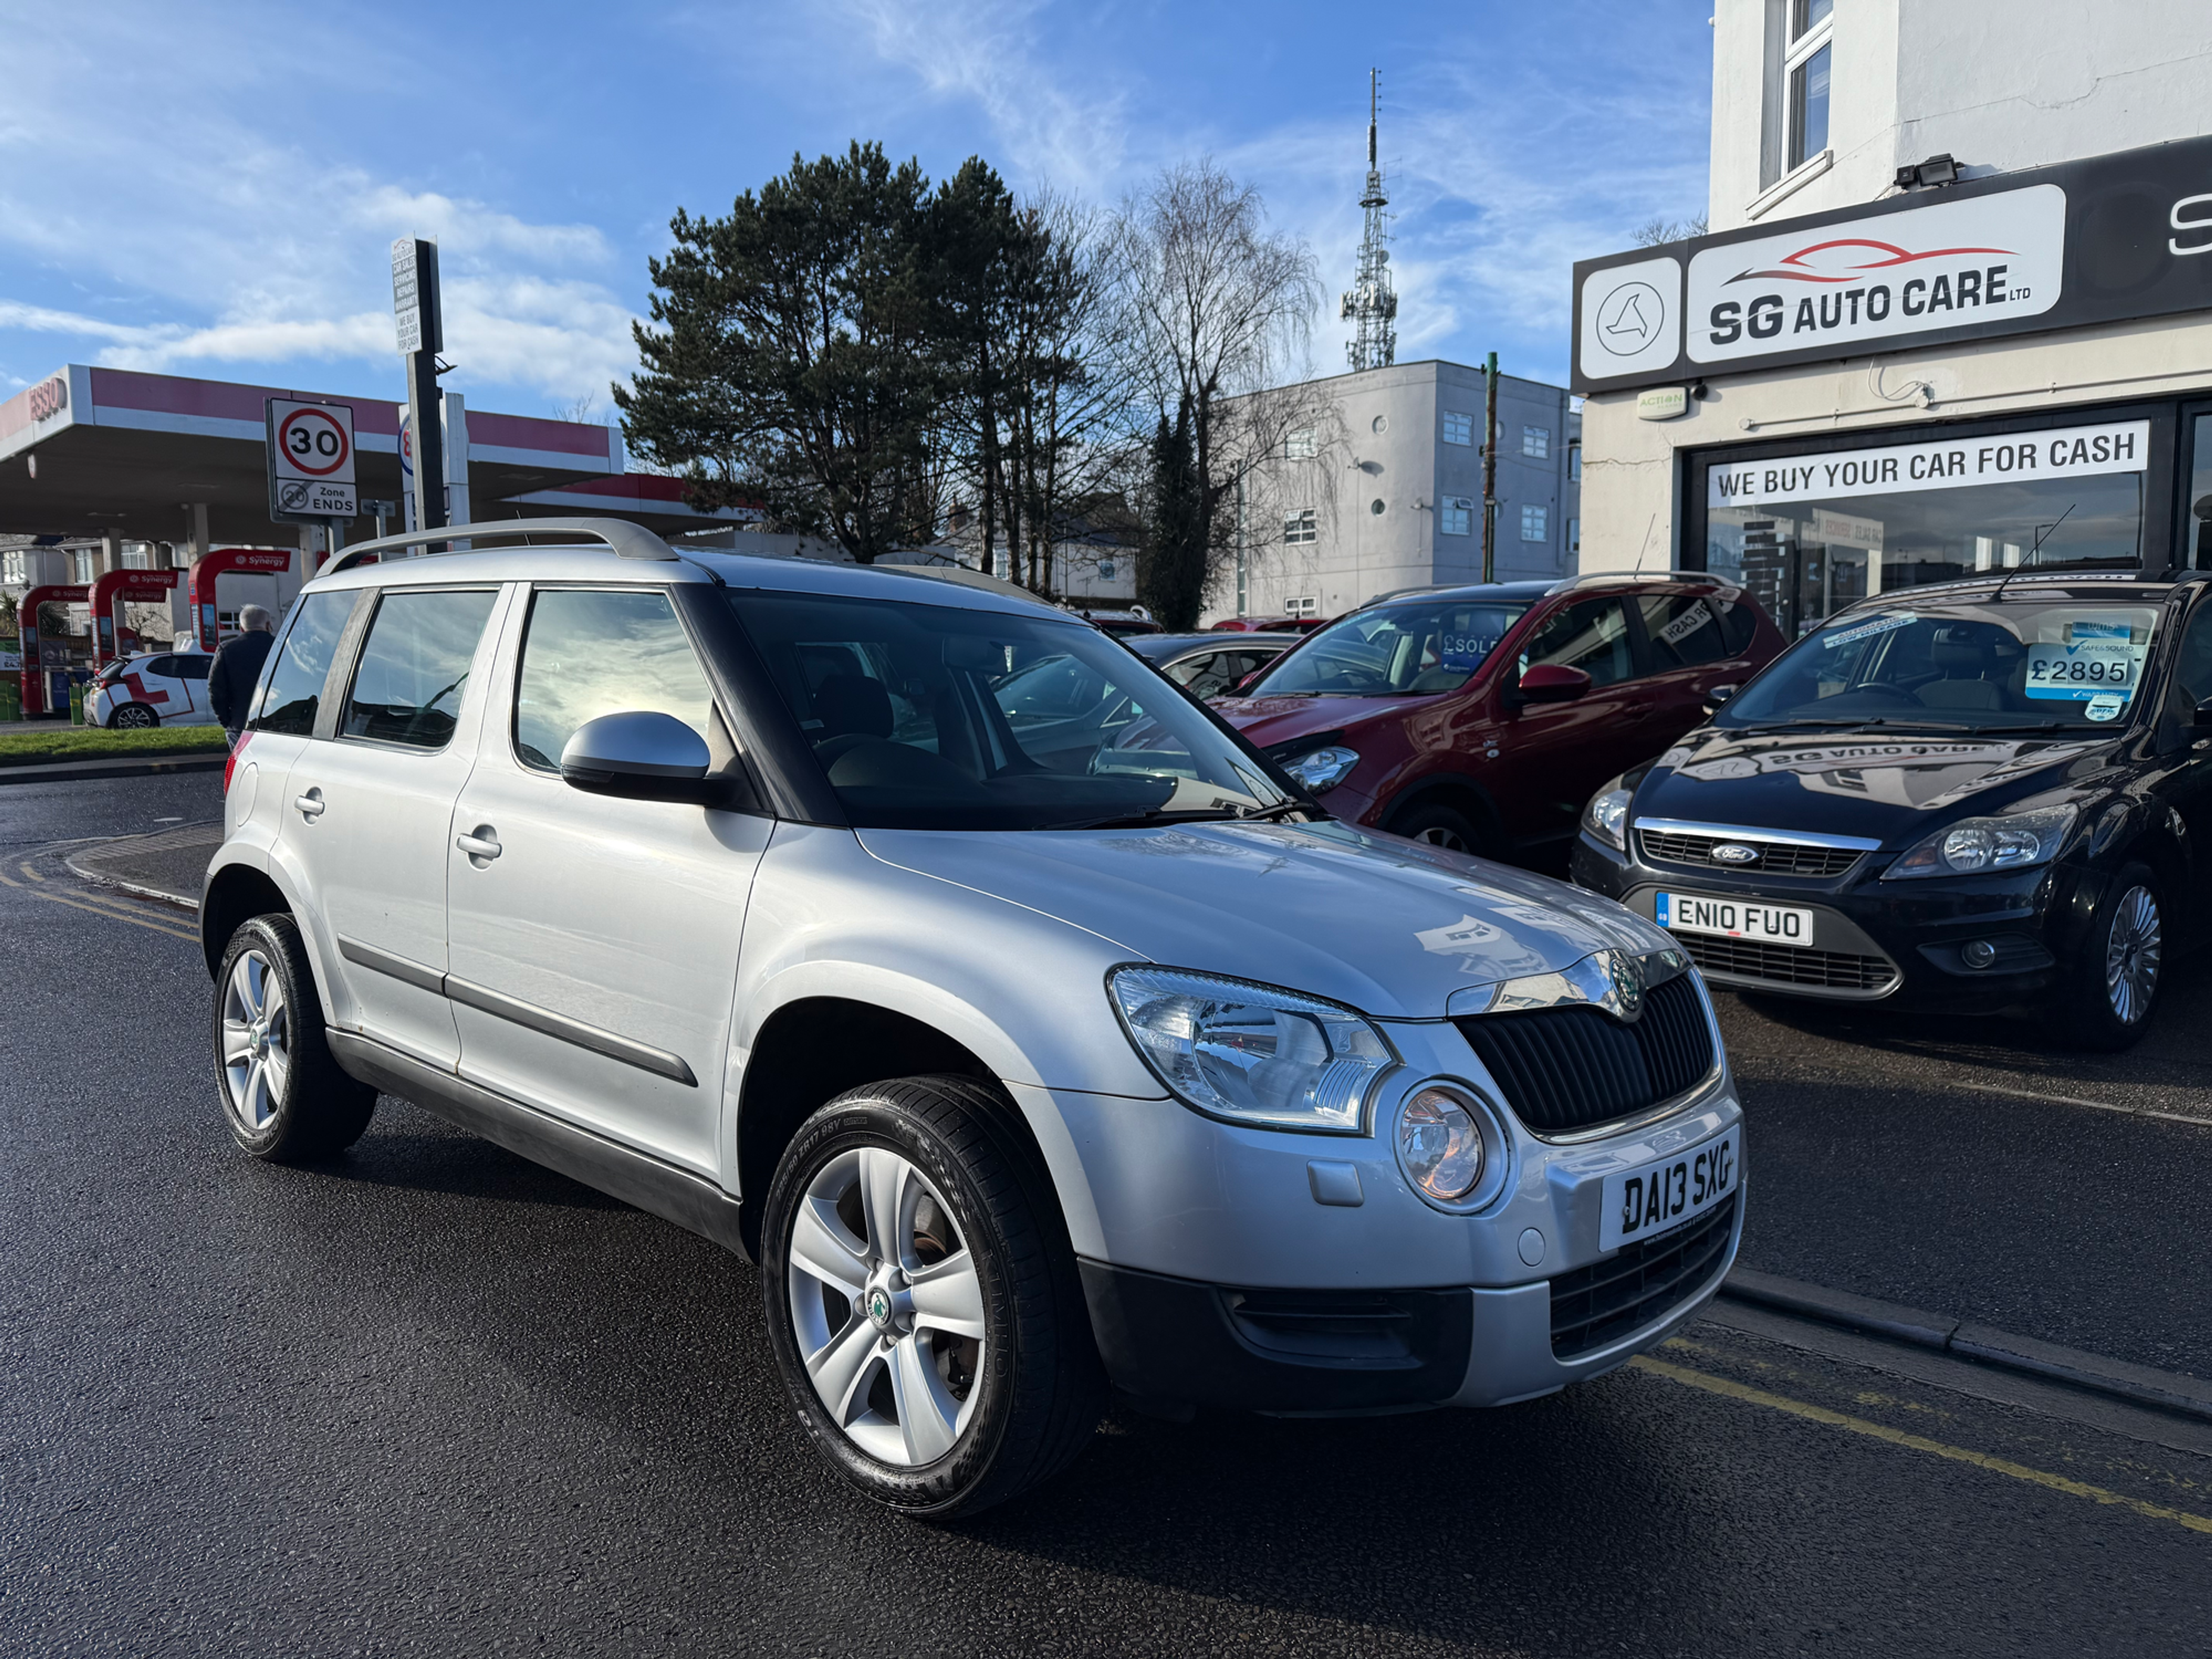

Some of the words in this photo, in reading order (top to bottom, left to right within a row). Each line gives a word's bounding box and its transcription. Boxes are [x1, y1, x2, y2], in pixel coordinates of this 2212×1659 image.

[1710, 294, 1784, 345] SG
[1793, 285, 1891, 333] AUTO
[1902, 264, 2008, 316] CARE
[2009, 287, 2031, 302] LTD
[290, 427, 338, 456] 30
[1719, 472, 1755, 497] WE
[1764, 465, 1815, 493] BUY
[1824, 457, 1898, 488] YOUR
[1910, 450, 1965, 480] CAR
[1978, 443, 2037, 473] FOR
[2050, 433, 2134, 467] CASH
[313, 499, 353, 511] ENDS
[320, 487, 345, 498] Zone
[249, 556, 284, 567] Synergy
[141, 575, 173, 584] Synergy
[1833, 635, 1857, 645] LOW
[1861, 620, 1908, 637] MILEAGE
[2032, 659, 2125, 682] £2895
[1722, 847, 1747, 859] Ford
[1679, 899, 1735, 929] EN10
[1745, 907, 1800, 938] FUO
[798, 1130, 820, 1159] ZR17
[1623, 1161, 1687, 1235] DA13
[1693, 1140, 1729, 1206] SXG
[980, 1249, 1009, 1378] KUMHO
